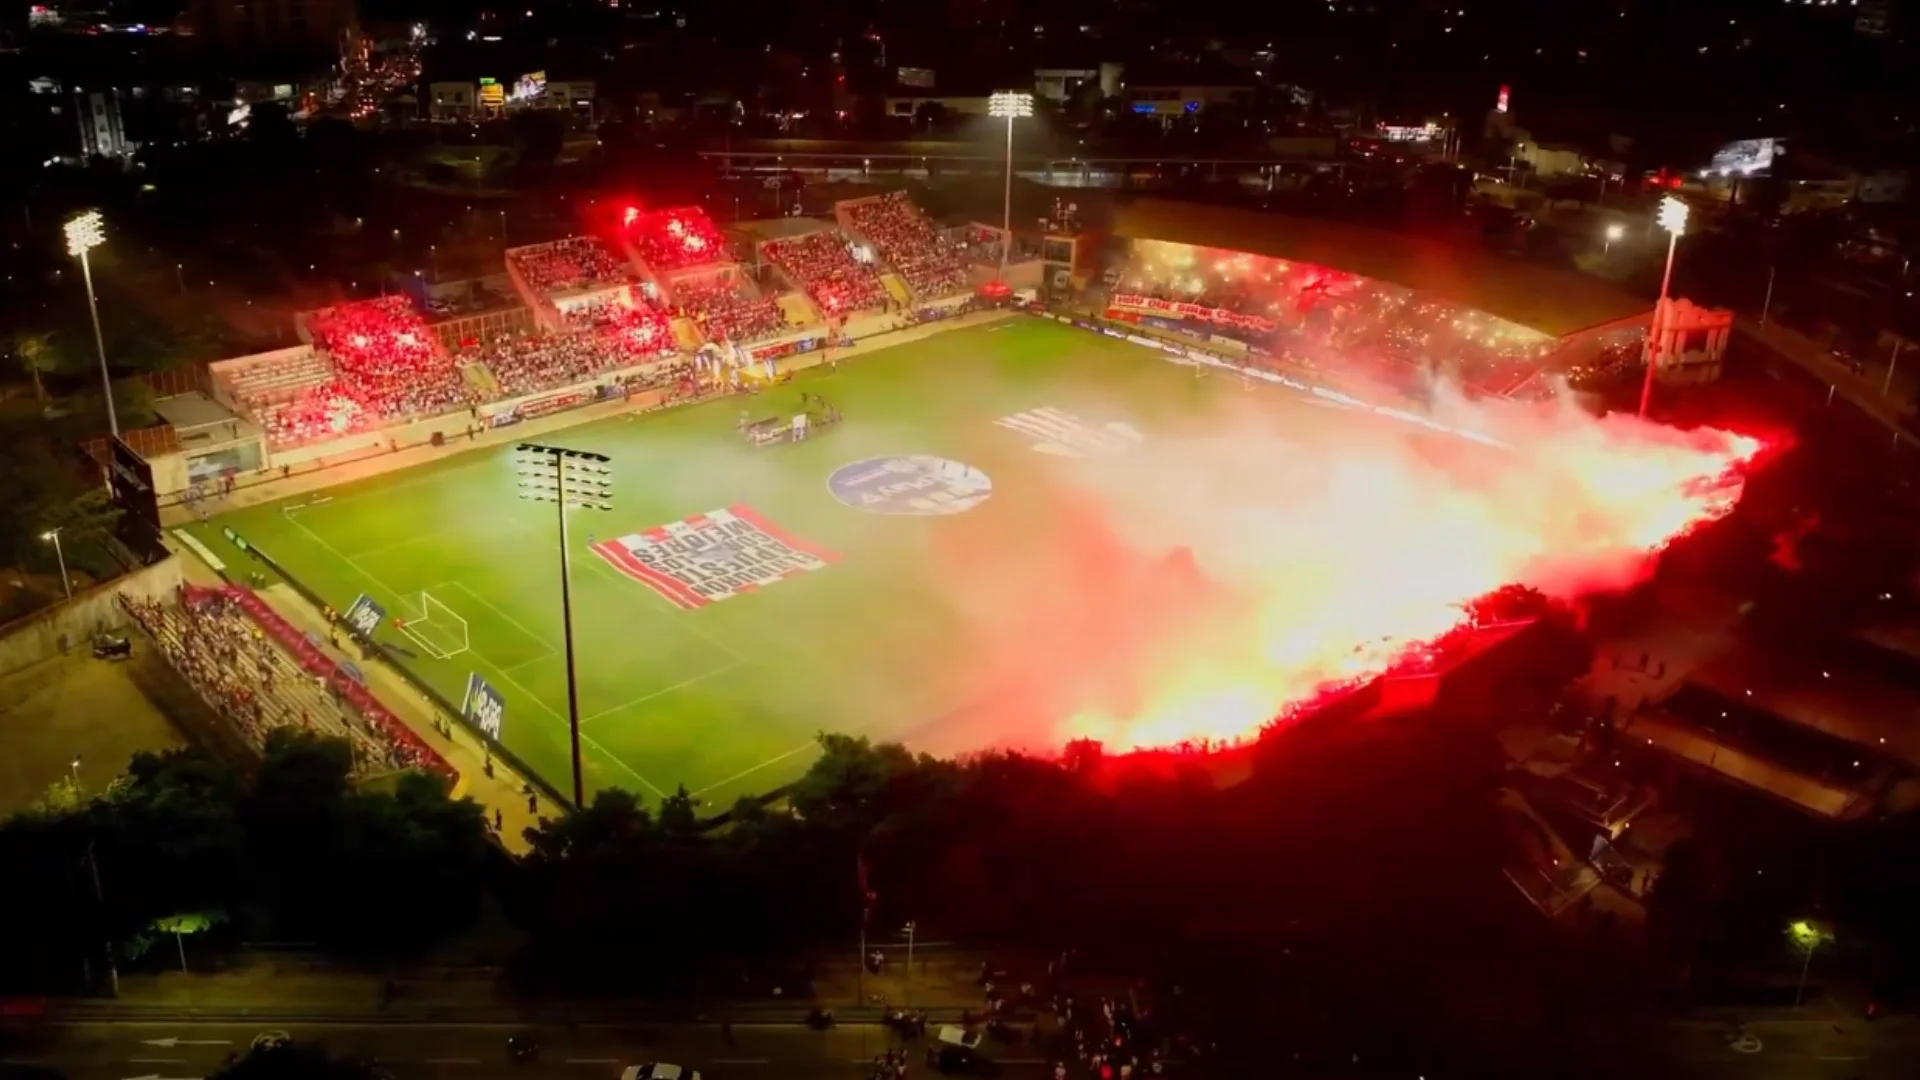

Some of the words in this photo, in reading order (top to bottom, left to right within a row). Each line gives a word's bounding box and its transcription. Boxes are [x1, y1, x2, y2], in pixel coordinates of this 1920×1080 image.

[627, 519, 756, 563] MEJORES
[720, 531, 774, 552] CON
[646, 555, 696, 574] LOS
[667, 540, 792, 585] APUESTA
